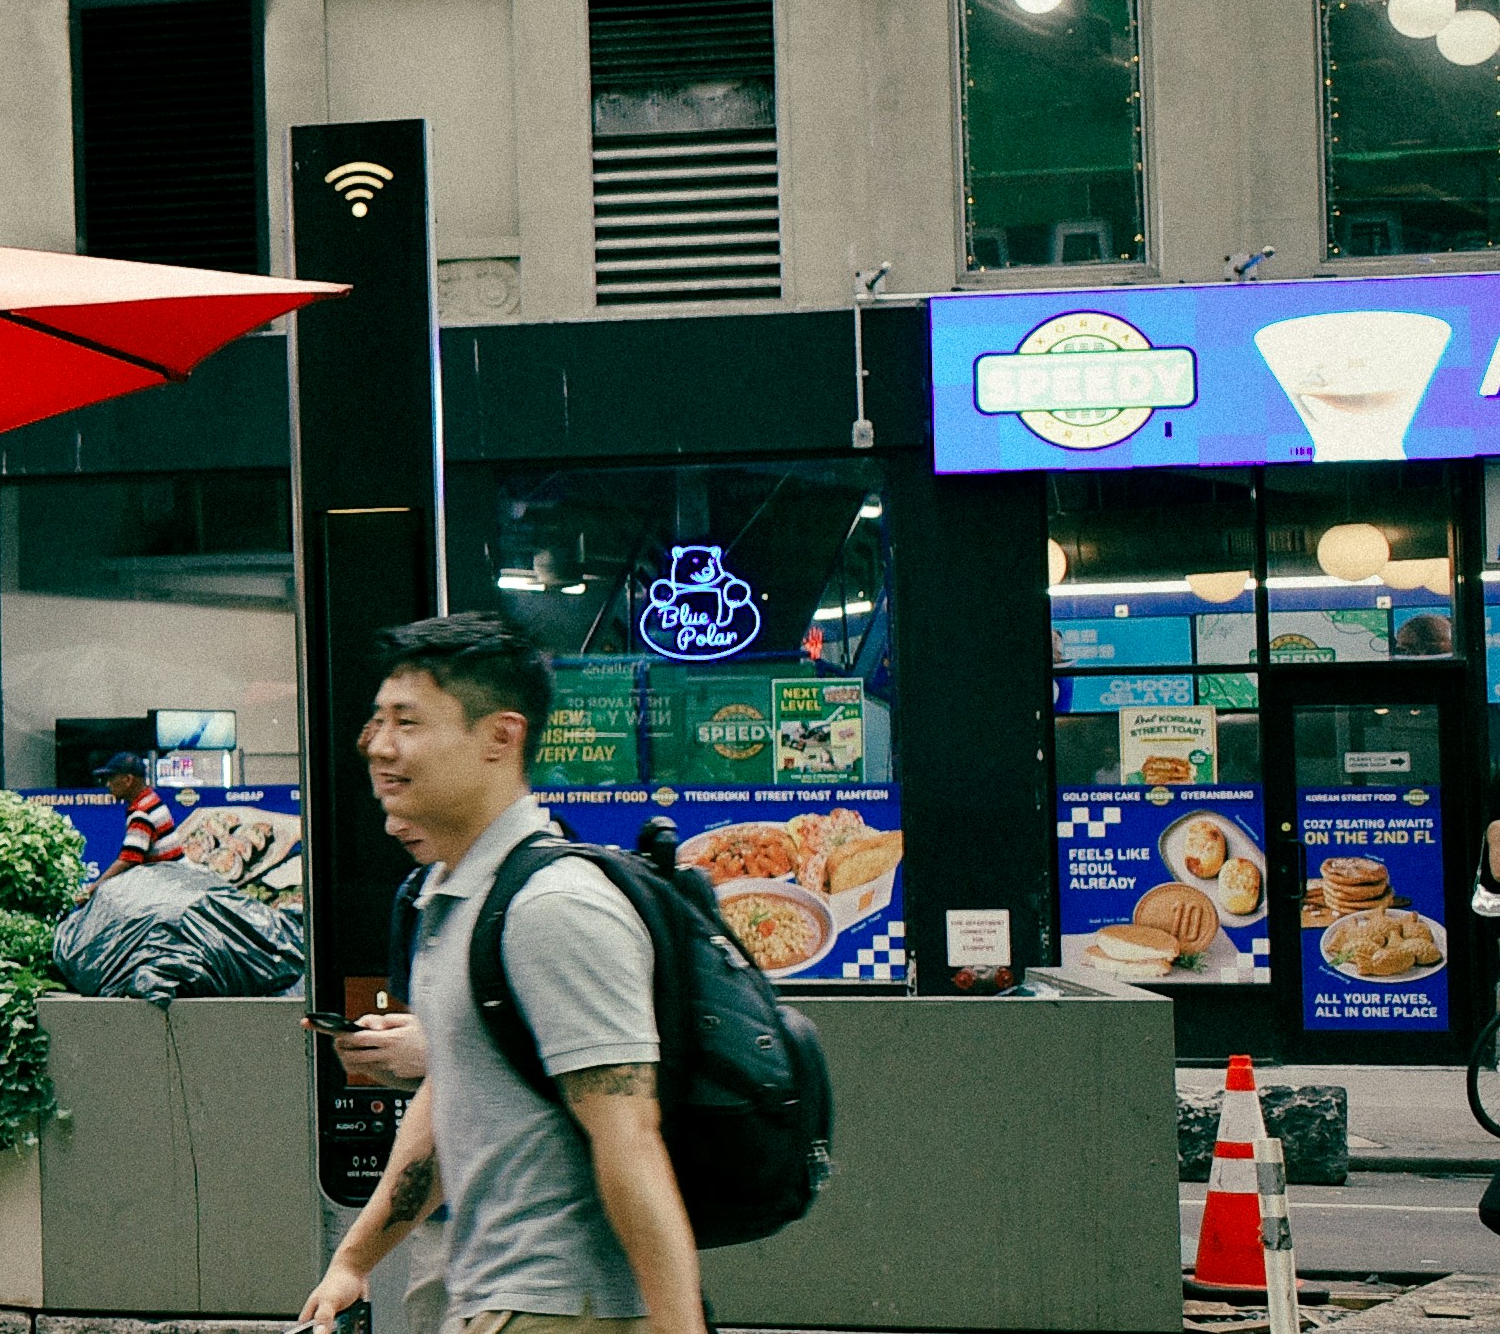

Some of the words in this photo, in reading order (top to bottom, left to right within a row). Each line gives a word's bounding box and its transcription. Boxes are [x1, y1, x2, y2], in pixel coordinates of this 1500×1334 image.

[985, 363, 1187, 402] SPEEDY
[658, 603, 710, 629] Blue
[677, 623, 738, 651] Polar
[783, 688, 819, 699] NEXT
[781, 700, 821, 712] LEVEL
[567, 792, 612, 803] STREET
[615, 791, 648, 803] FOOD
[754, 790, 794, 802] STREET
[797, 789, 832, 801] TOAST
[1304, 819, 1333, 829] COZY
[1336, 819, 1385, 829] SEATING
[1388, 819, 1433, 829] AWAITS
[1304, 831, 1329, 844] ON
[1334, 831, 1368, 844] THE
[1374, 831, 1408, 844] 2ND
[1414, 831, 1435, 844] FL
[1069, 849, 1114, 861] FEELS
[1069, 863, 1117, 875] SEOUL
[1070, 877, 1136, 890] ALREADY
[1315, 993, 1340, 1005] ALL
[1344, 993, 1381, 1005] YOUR
[1384, 993, 1431, 1006] FAVES,
[1316, 1006, 1342, 1017] ALL
[1345, 1006, 1358, 1017] IN
[1362, 1006, 1390, 1017] ONE
[1394, 1006, 1437, 1018] PLACE
